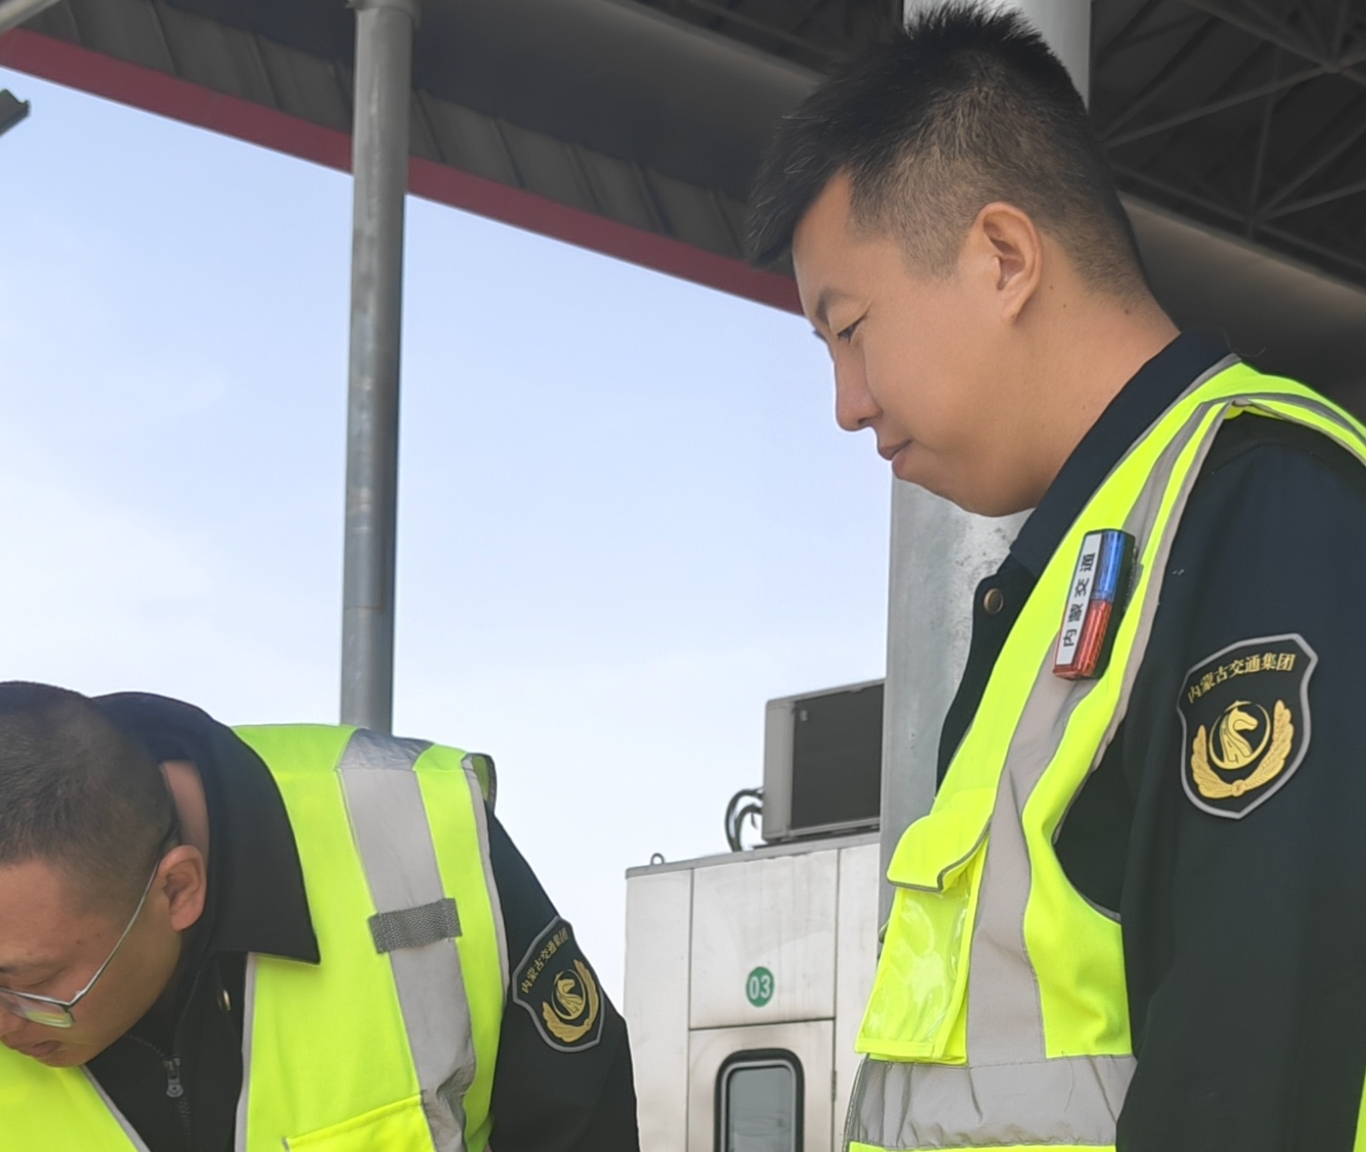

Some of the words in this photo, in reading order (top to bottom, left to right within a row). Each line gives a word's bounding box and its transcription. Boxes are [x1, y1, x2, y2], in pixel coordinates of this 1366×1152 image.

[1187, 652, 1296, 704] 内蒙古交通集团
[749, 974, 771, 999] 03
